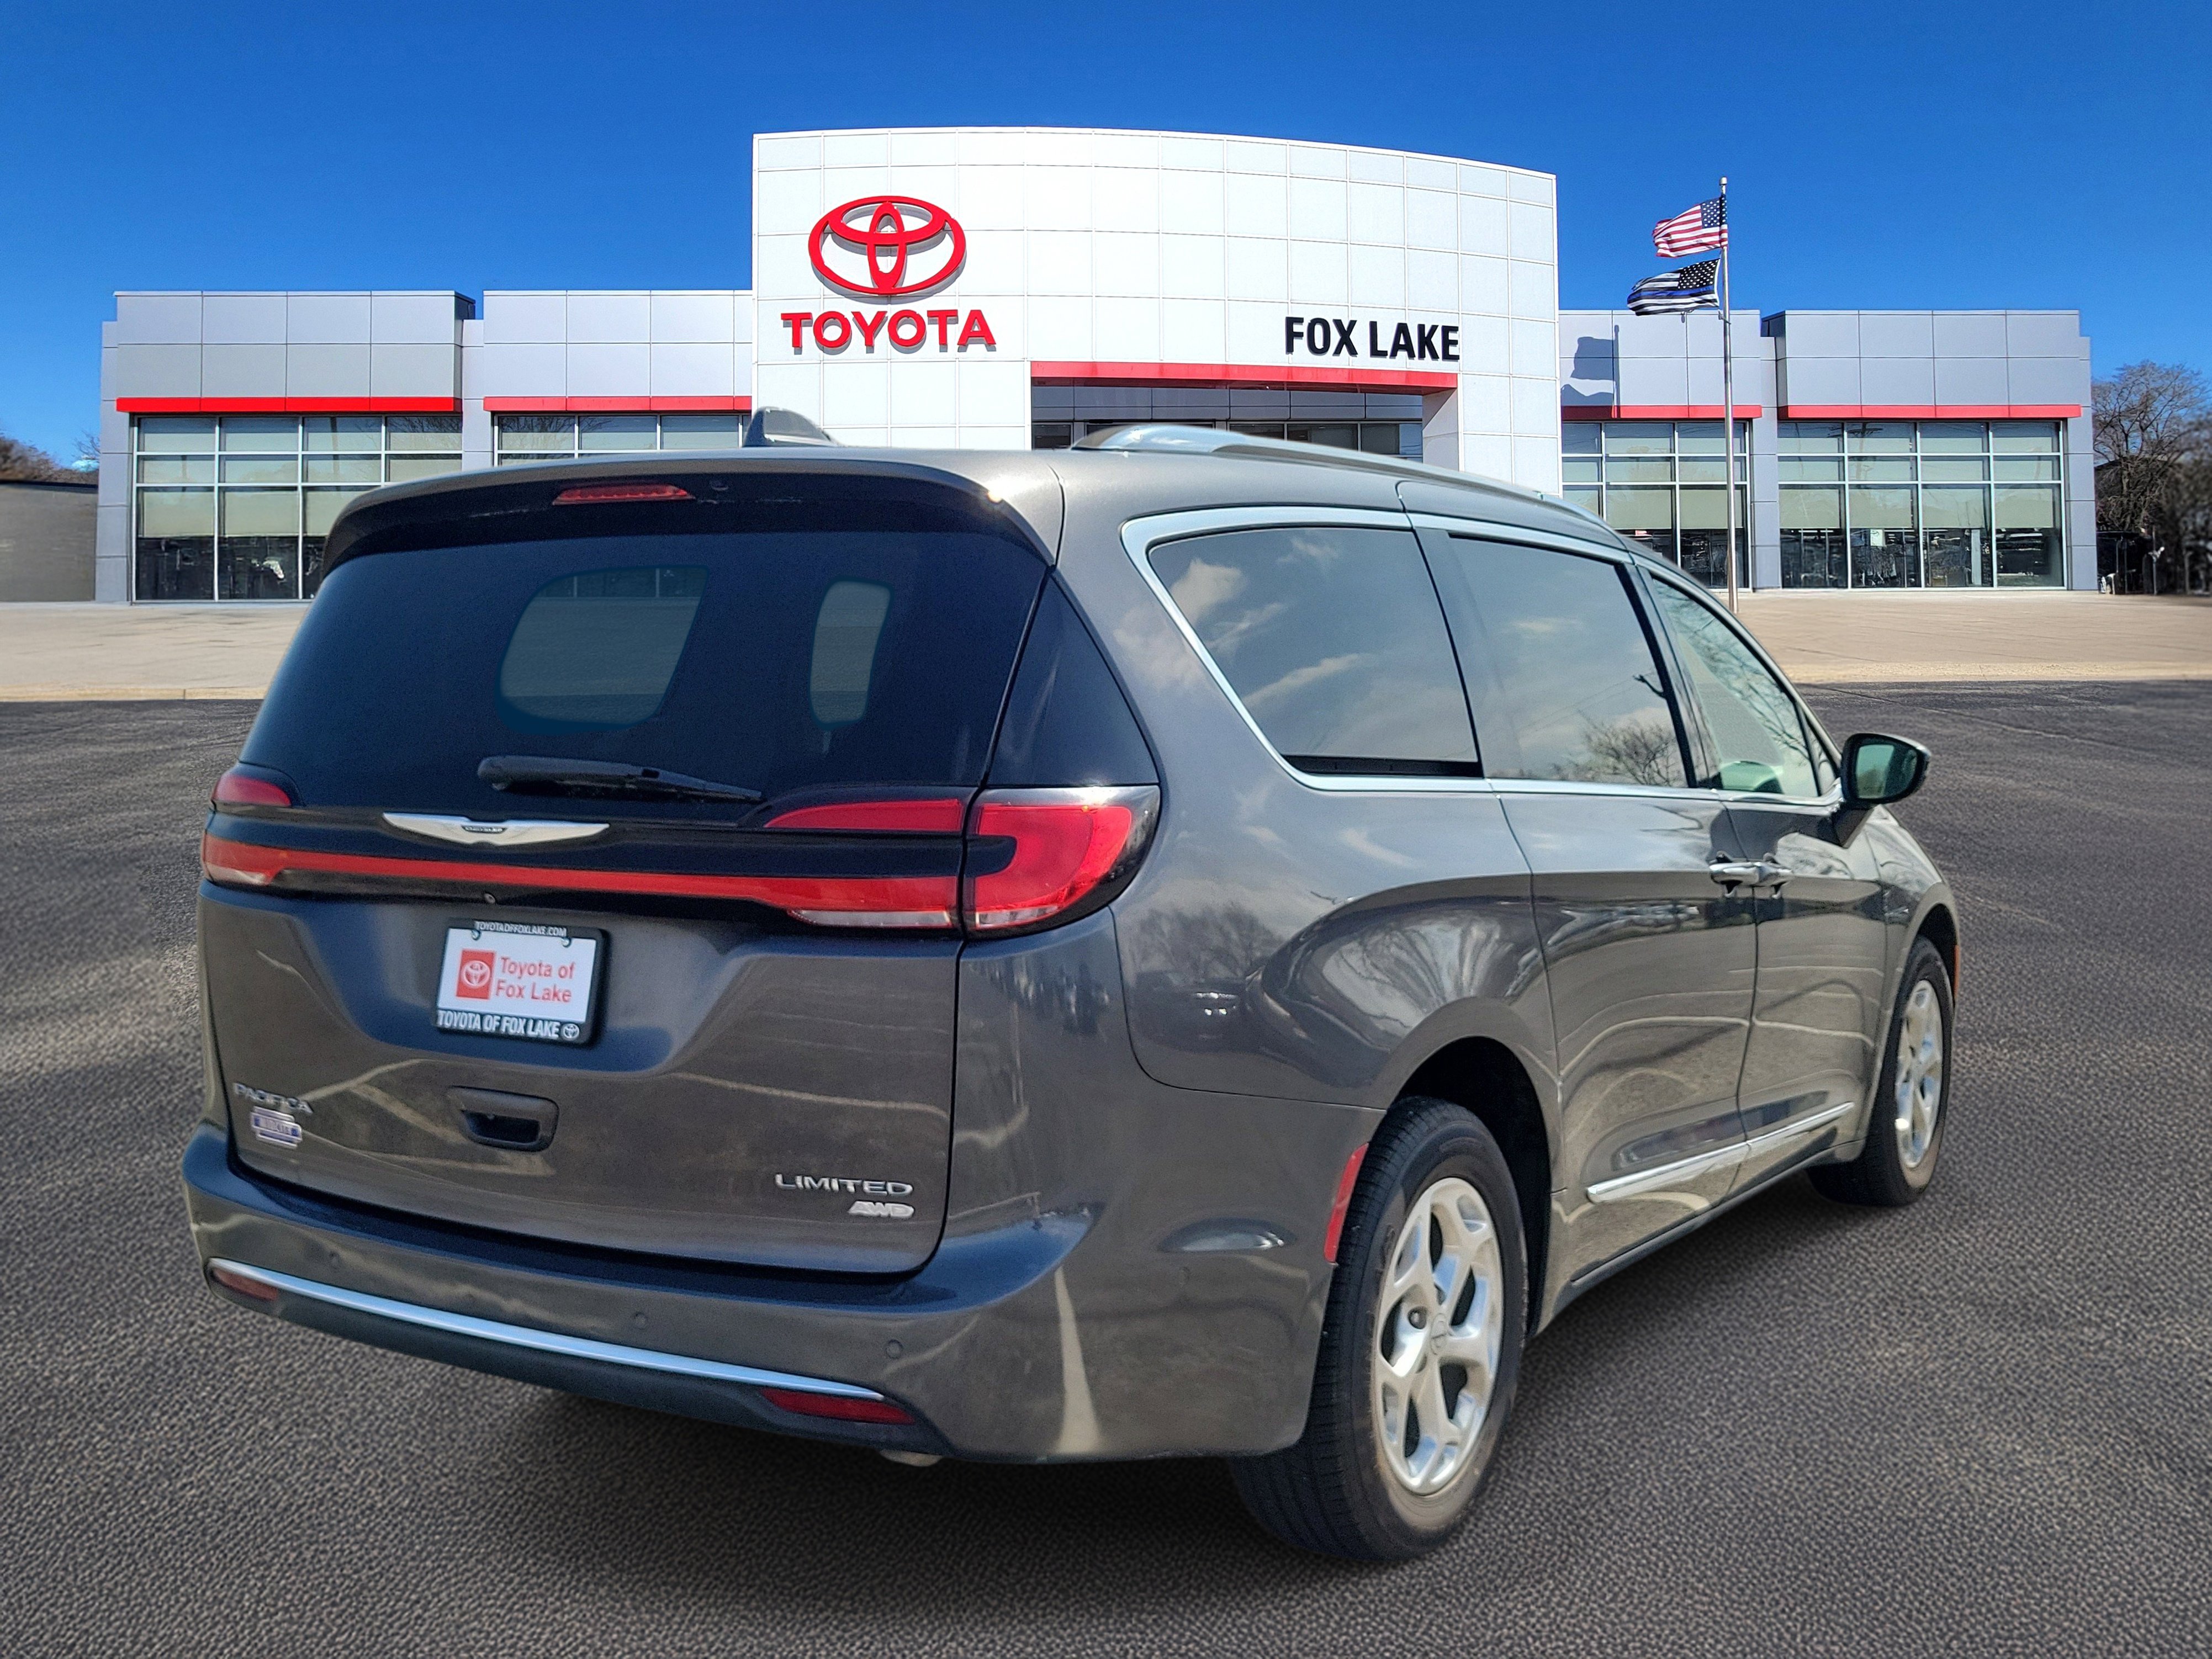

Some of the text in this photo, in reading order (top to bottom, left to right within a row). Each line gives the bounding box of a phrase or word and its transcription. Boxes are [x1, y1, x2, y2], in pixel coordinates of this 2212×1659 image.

[780, 309, 997, 351] TOYOTA
[1285, 316, 1460, 362] FOX LAKE
[500, 956, 576, 979] Toyota of
[495, 979, 572, 1003] Fox Lake
[437, 1009, 561, 1040] TOYOTA OF FOX LAKE
[774, 1173, 913, 1196] LIMITED
[847, 1200, 915, 1218] AWD
